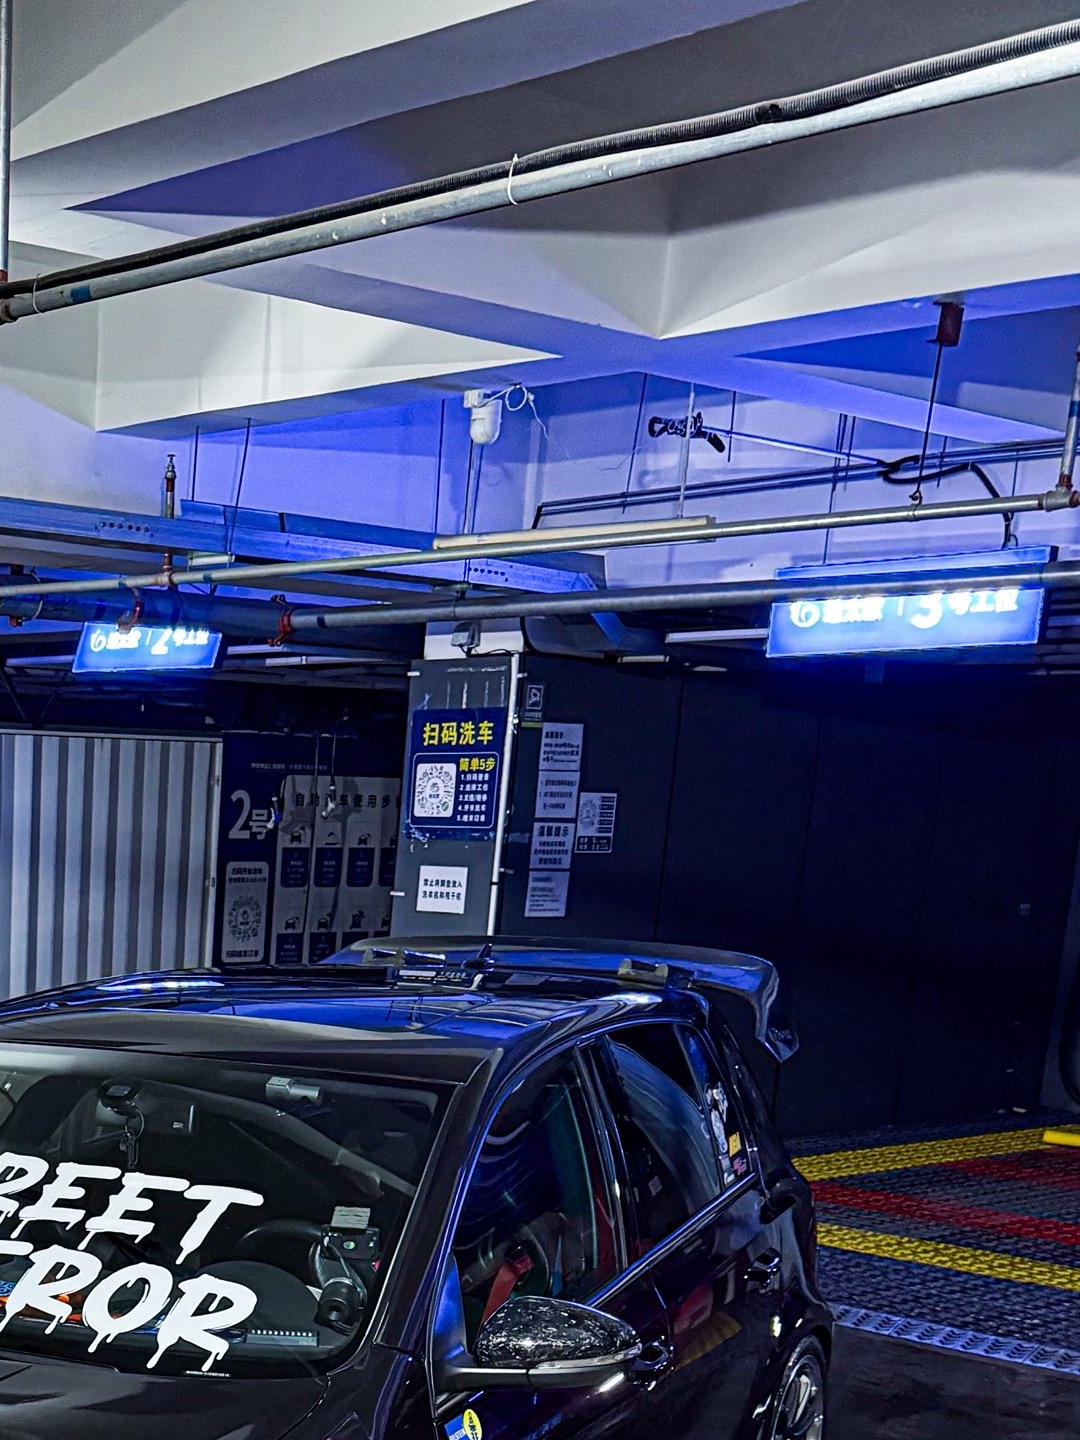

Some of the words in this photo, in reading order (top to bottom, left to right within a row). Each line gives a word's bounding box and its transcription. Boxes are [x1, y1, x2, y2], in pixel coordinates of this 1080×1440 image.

[423, 720, 494, 746] 扫码洗车
[459, 757, 496, 772] 简单5步
[228, 789, 270, 841] 2号
